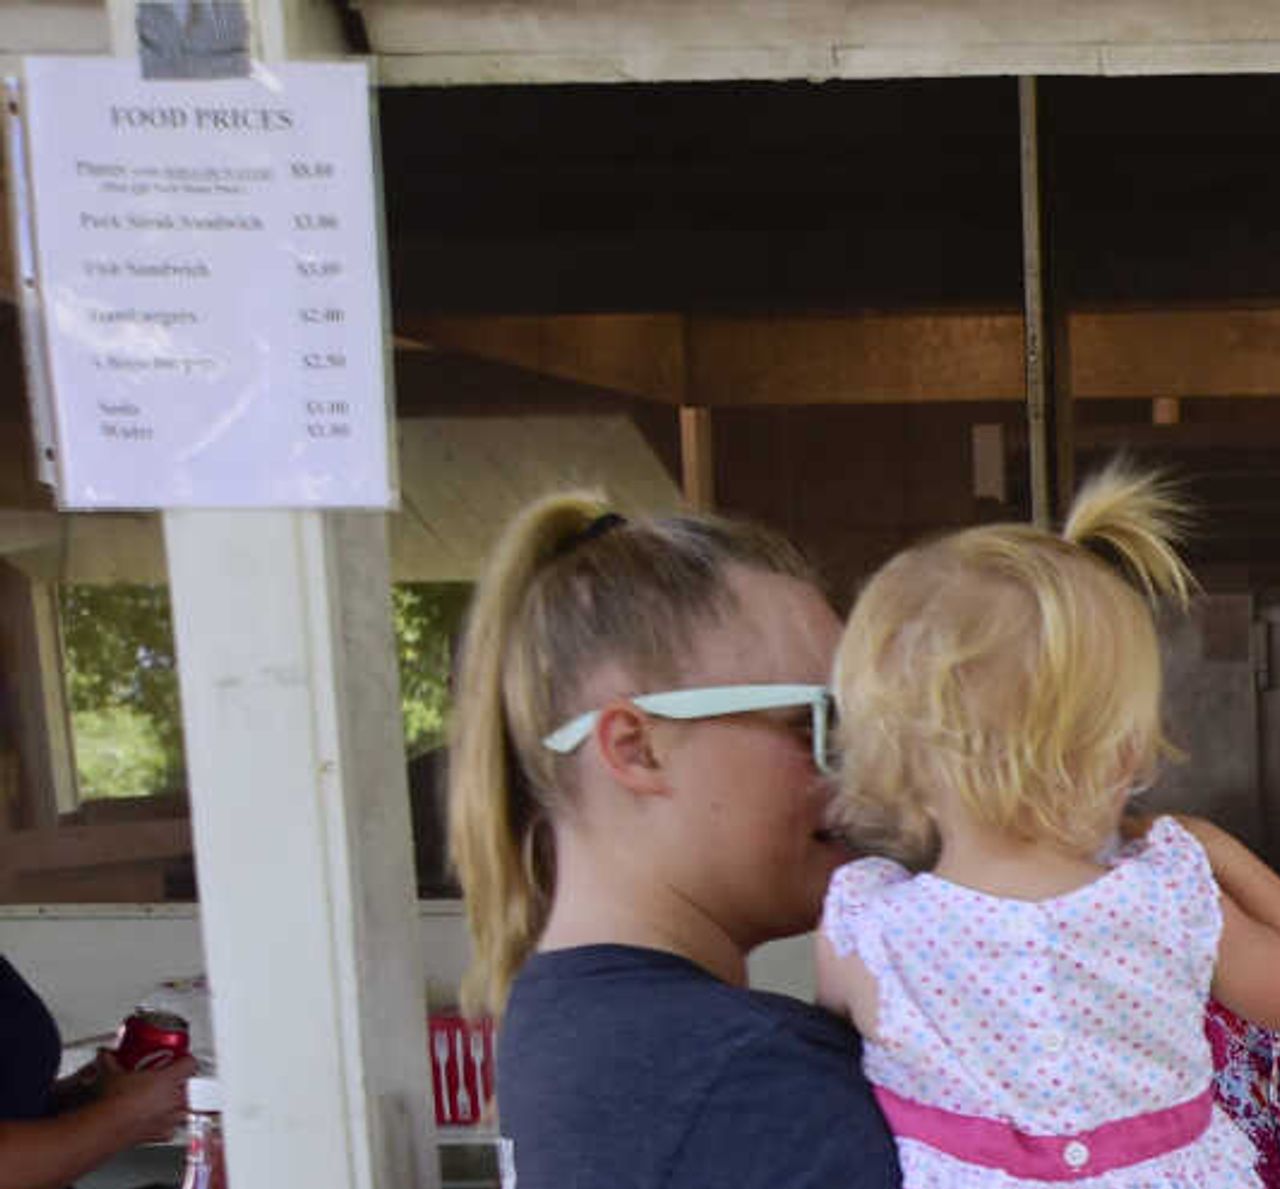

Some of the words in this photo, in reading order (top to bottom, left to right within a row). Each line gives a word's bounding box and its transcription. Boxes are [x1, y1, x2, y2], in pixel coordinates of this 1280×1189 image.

[109, 105, 188, 128] FOOD
[194, 107, 293, 131] PRICES
[179, 213, 265, 231] Sandwich
